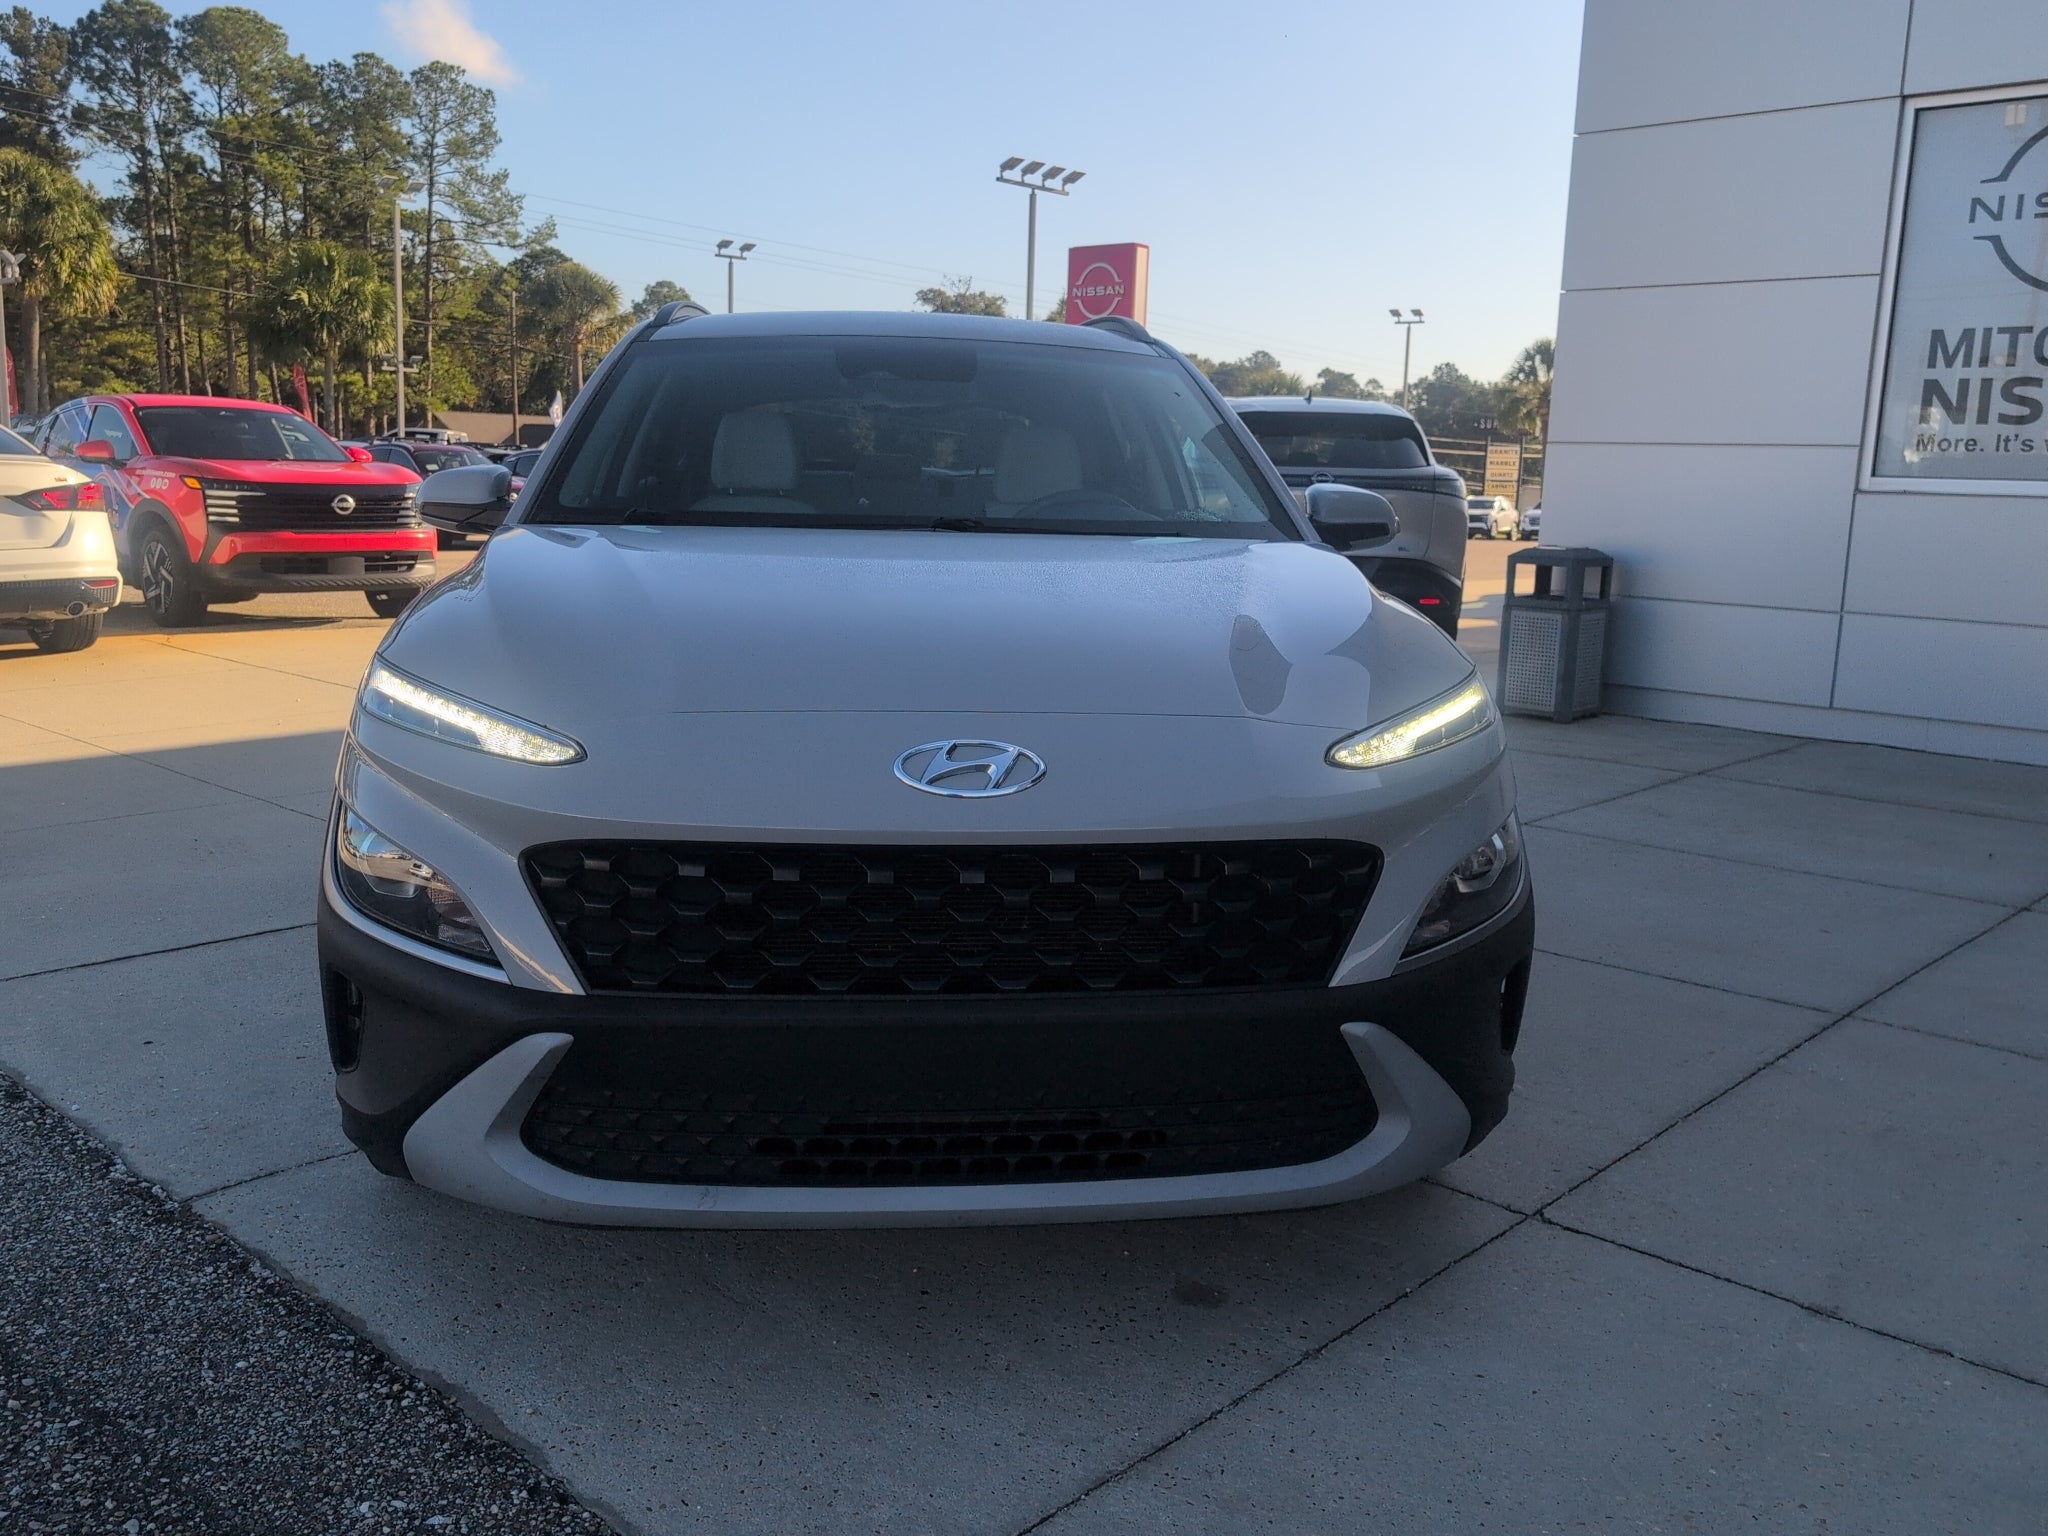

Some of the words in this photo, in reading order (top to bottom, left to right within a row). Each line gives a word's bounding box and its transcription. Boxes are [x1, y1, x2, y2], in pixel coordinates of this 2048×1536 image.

[1072, 285, 1125, 297] NISSAN
[1918, 376, 2044, 425] NIS
[1915, 433, 1984, 453] More.
